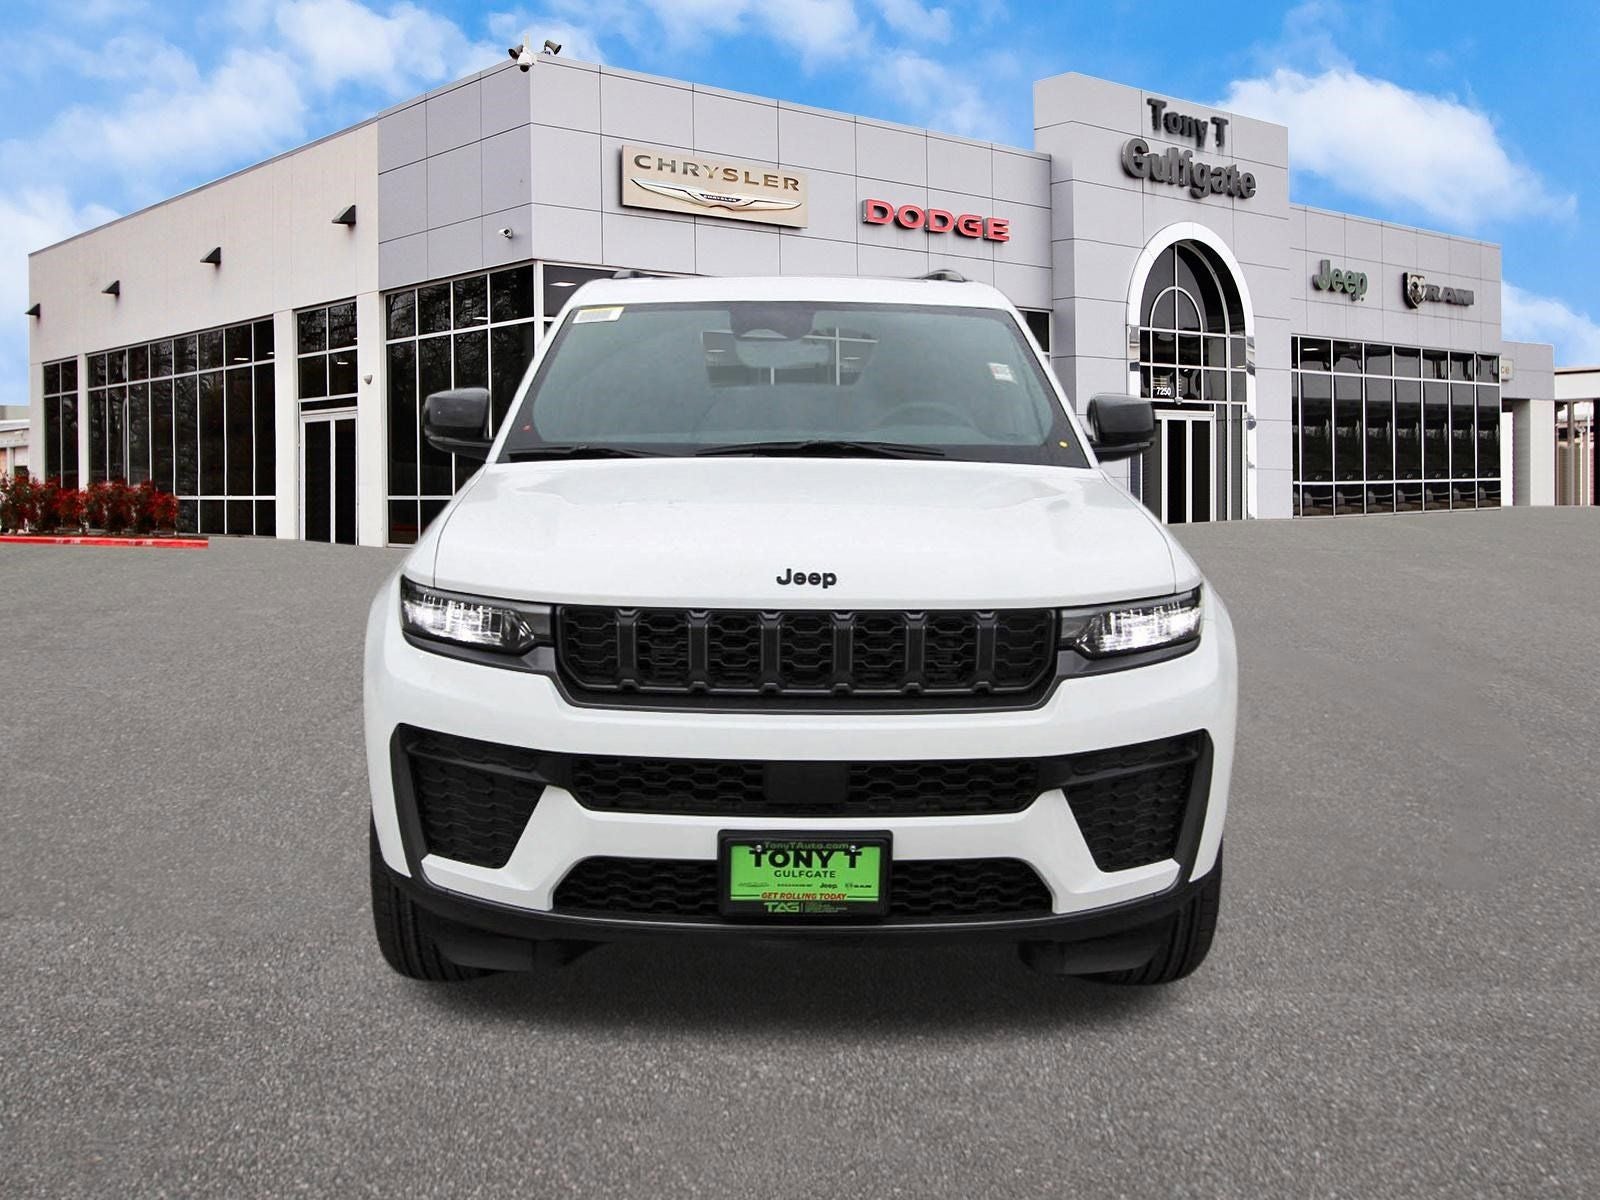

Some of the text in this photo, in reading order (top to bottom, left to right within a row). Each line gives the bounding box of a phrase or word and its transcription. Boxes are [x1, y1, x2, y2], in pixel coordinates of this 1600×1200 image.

[1146, 98, 1229, 147] Tony T
[632, 154, 801, 192] CHRYSLER
[1121, 138, 1257, 199] Gulfgate
[862, 198, 1011, 243] DODGE
[1313, 259, 1368, 302] Jeep
[1424, 283, 1475, 306] RAM
[1156, 386, 1172, 396] 7250
[776, 568, 837, 589] Jeep
[749, 847, 862, 868] TONY T
[774, 870, 836, 878] GULFGATE
[761, 892, 847, 901] GET ROLLING TODAY
[764, 902, 799, 913] TAG
